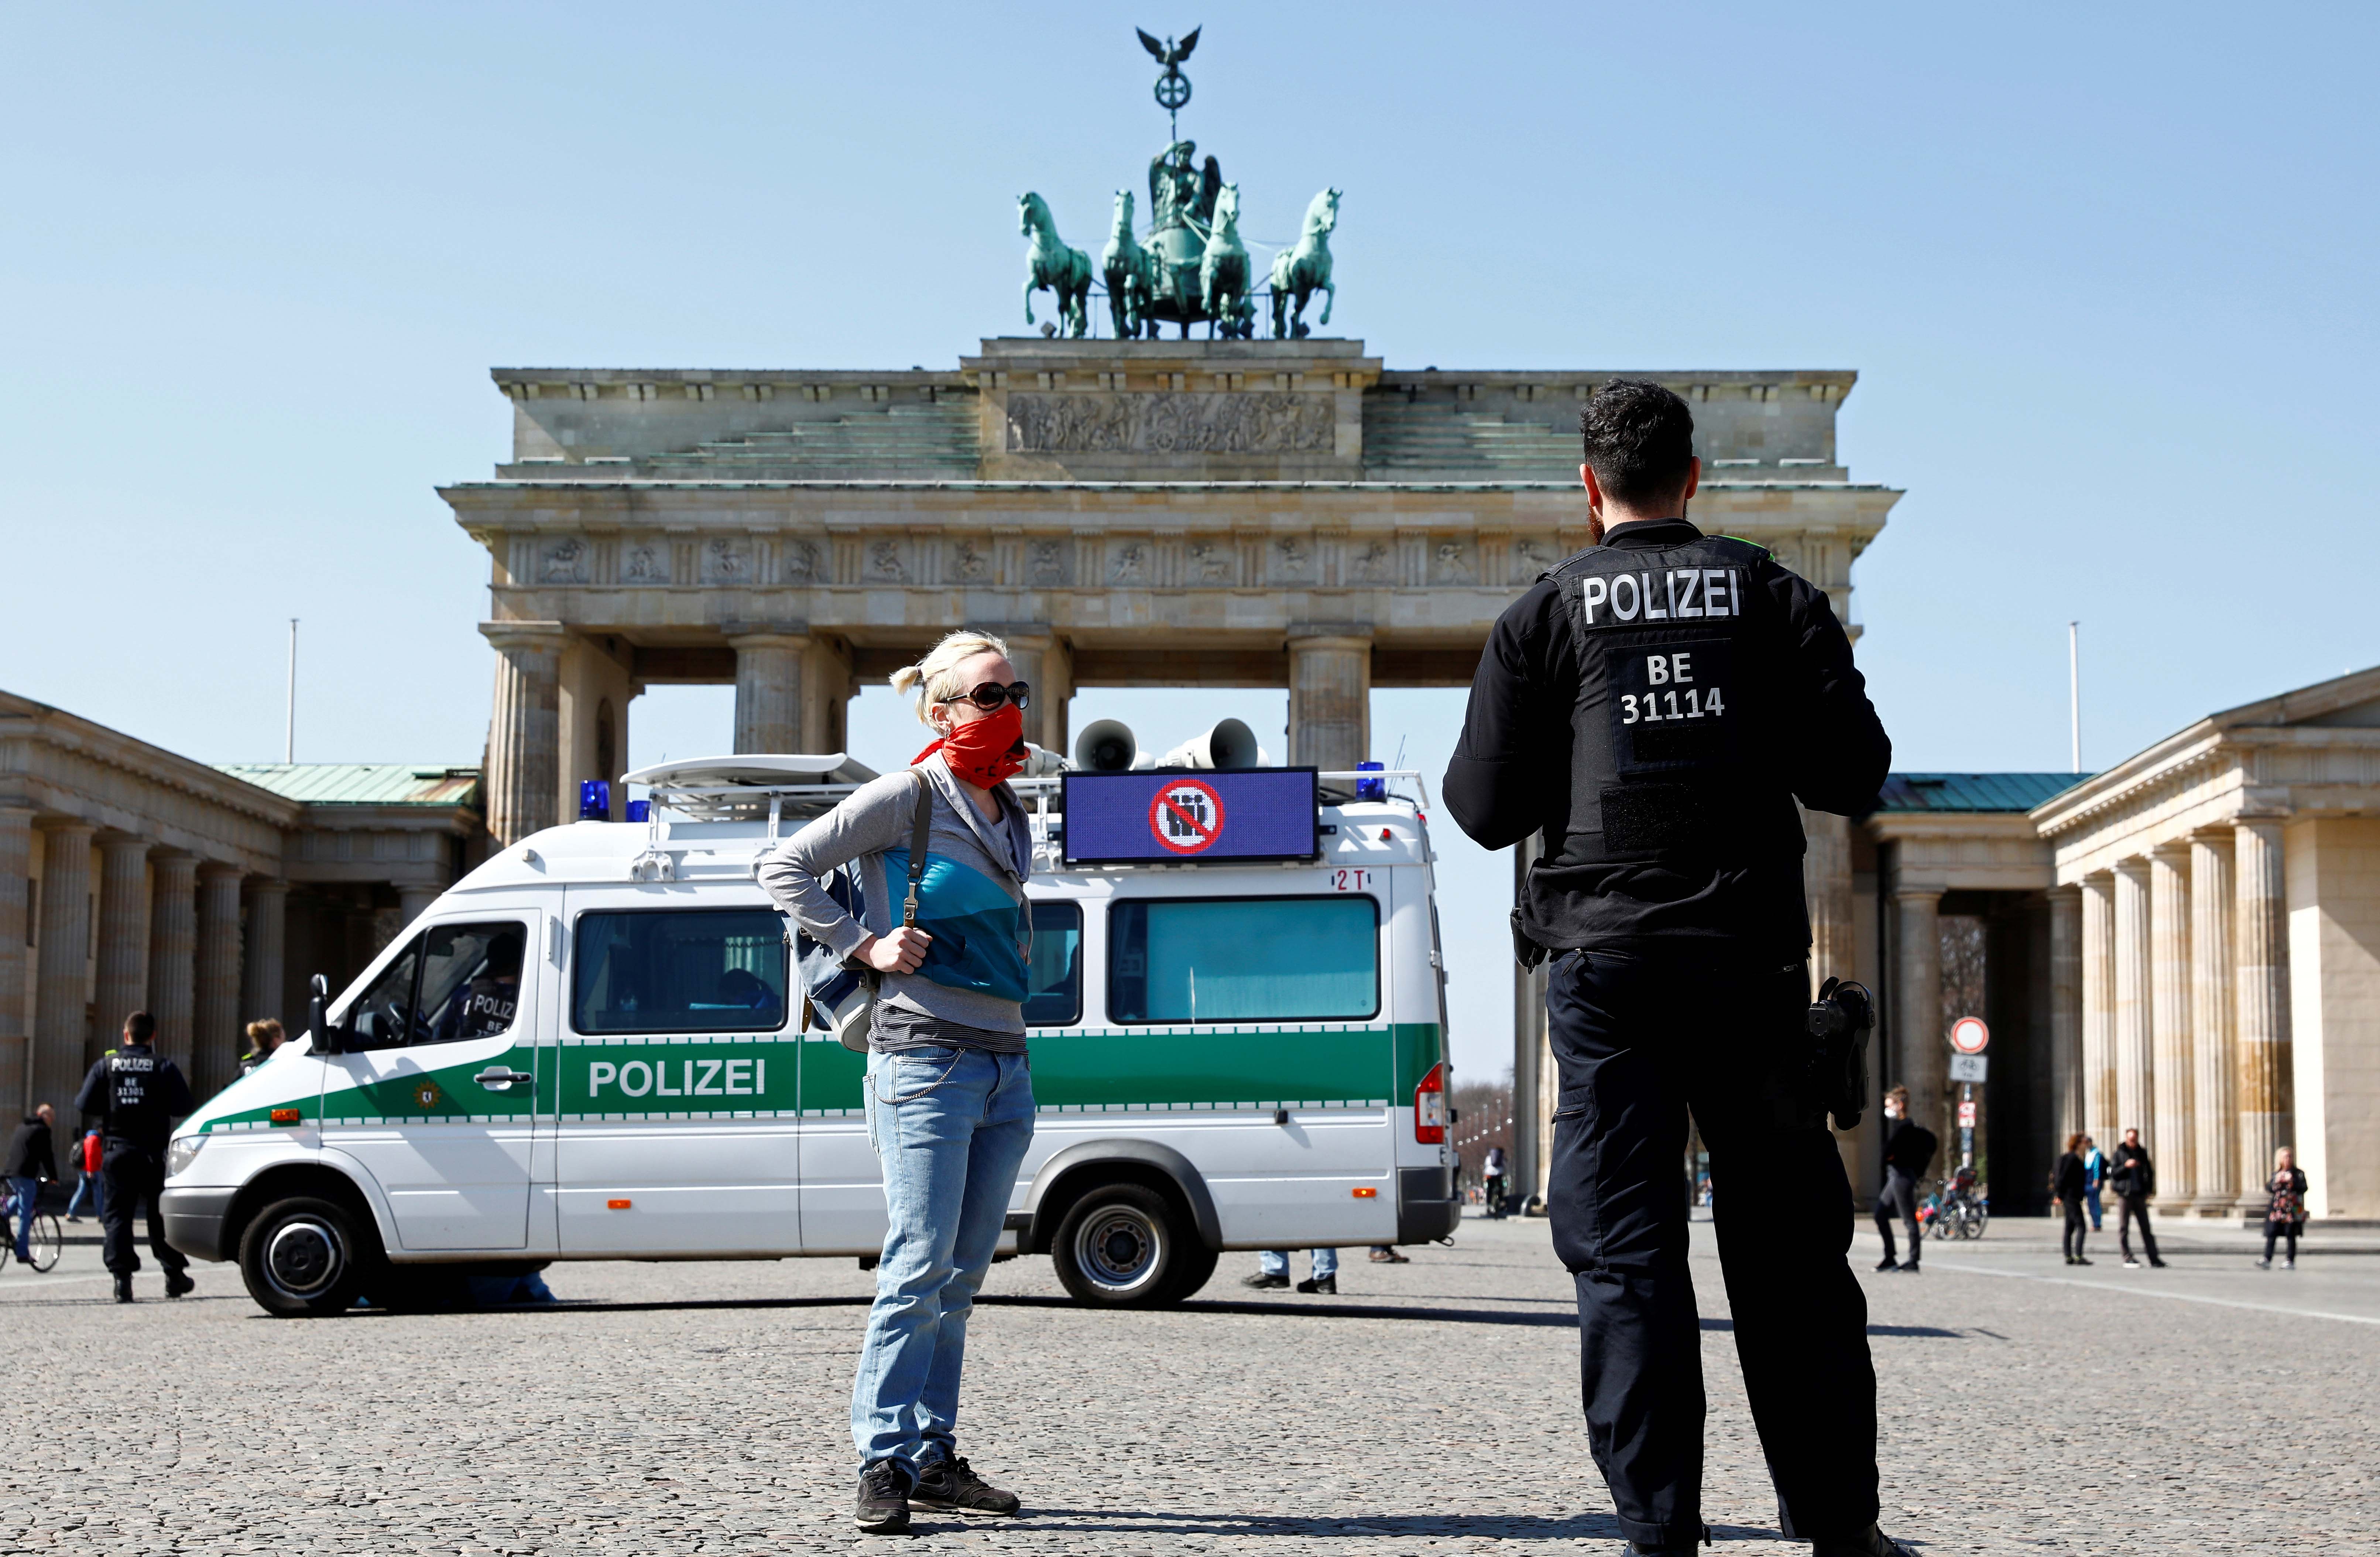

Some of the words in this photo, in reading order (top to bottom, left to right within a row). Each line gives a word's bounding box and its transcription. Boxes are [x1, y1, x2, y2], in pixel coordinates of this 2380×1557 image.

[1583, 569, 1739, 624] POLIZEI
[1647, 653, 1693, 685] BE
[1621, 687, 1725, 724] 31114
[473, 994, 514, 1019] POLIZ
[487, 1020, 503, 1033] BE
[112, 1057, 154, 1072] POLIZEI
[589, 1058, 765, 1097] POLIZEI
[124, 1077, 137, 1087] BE
